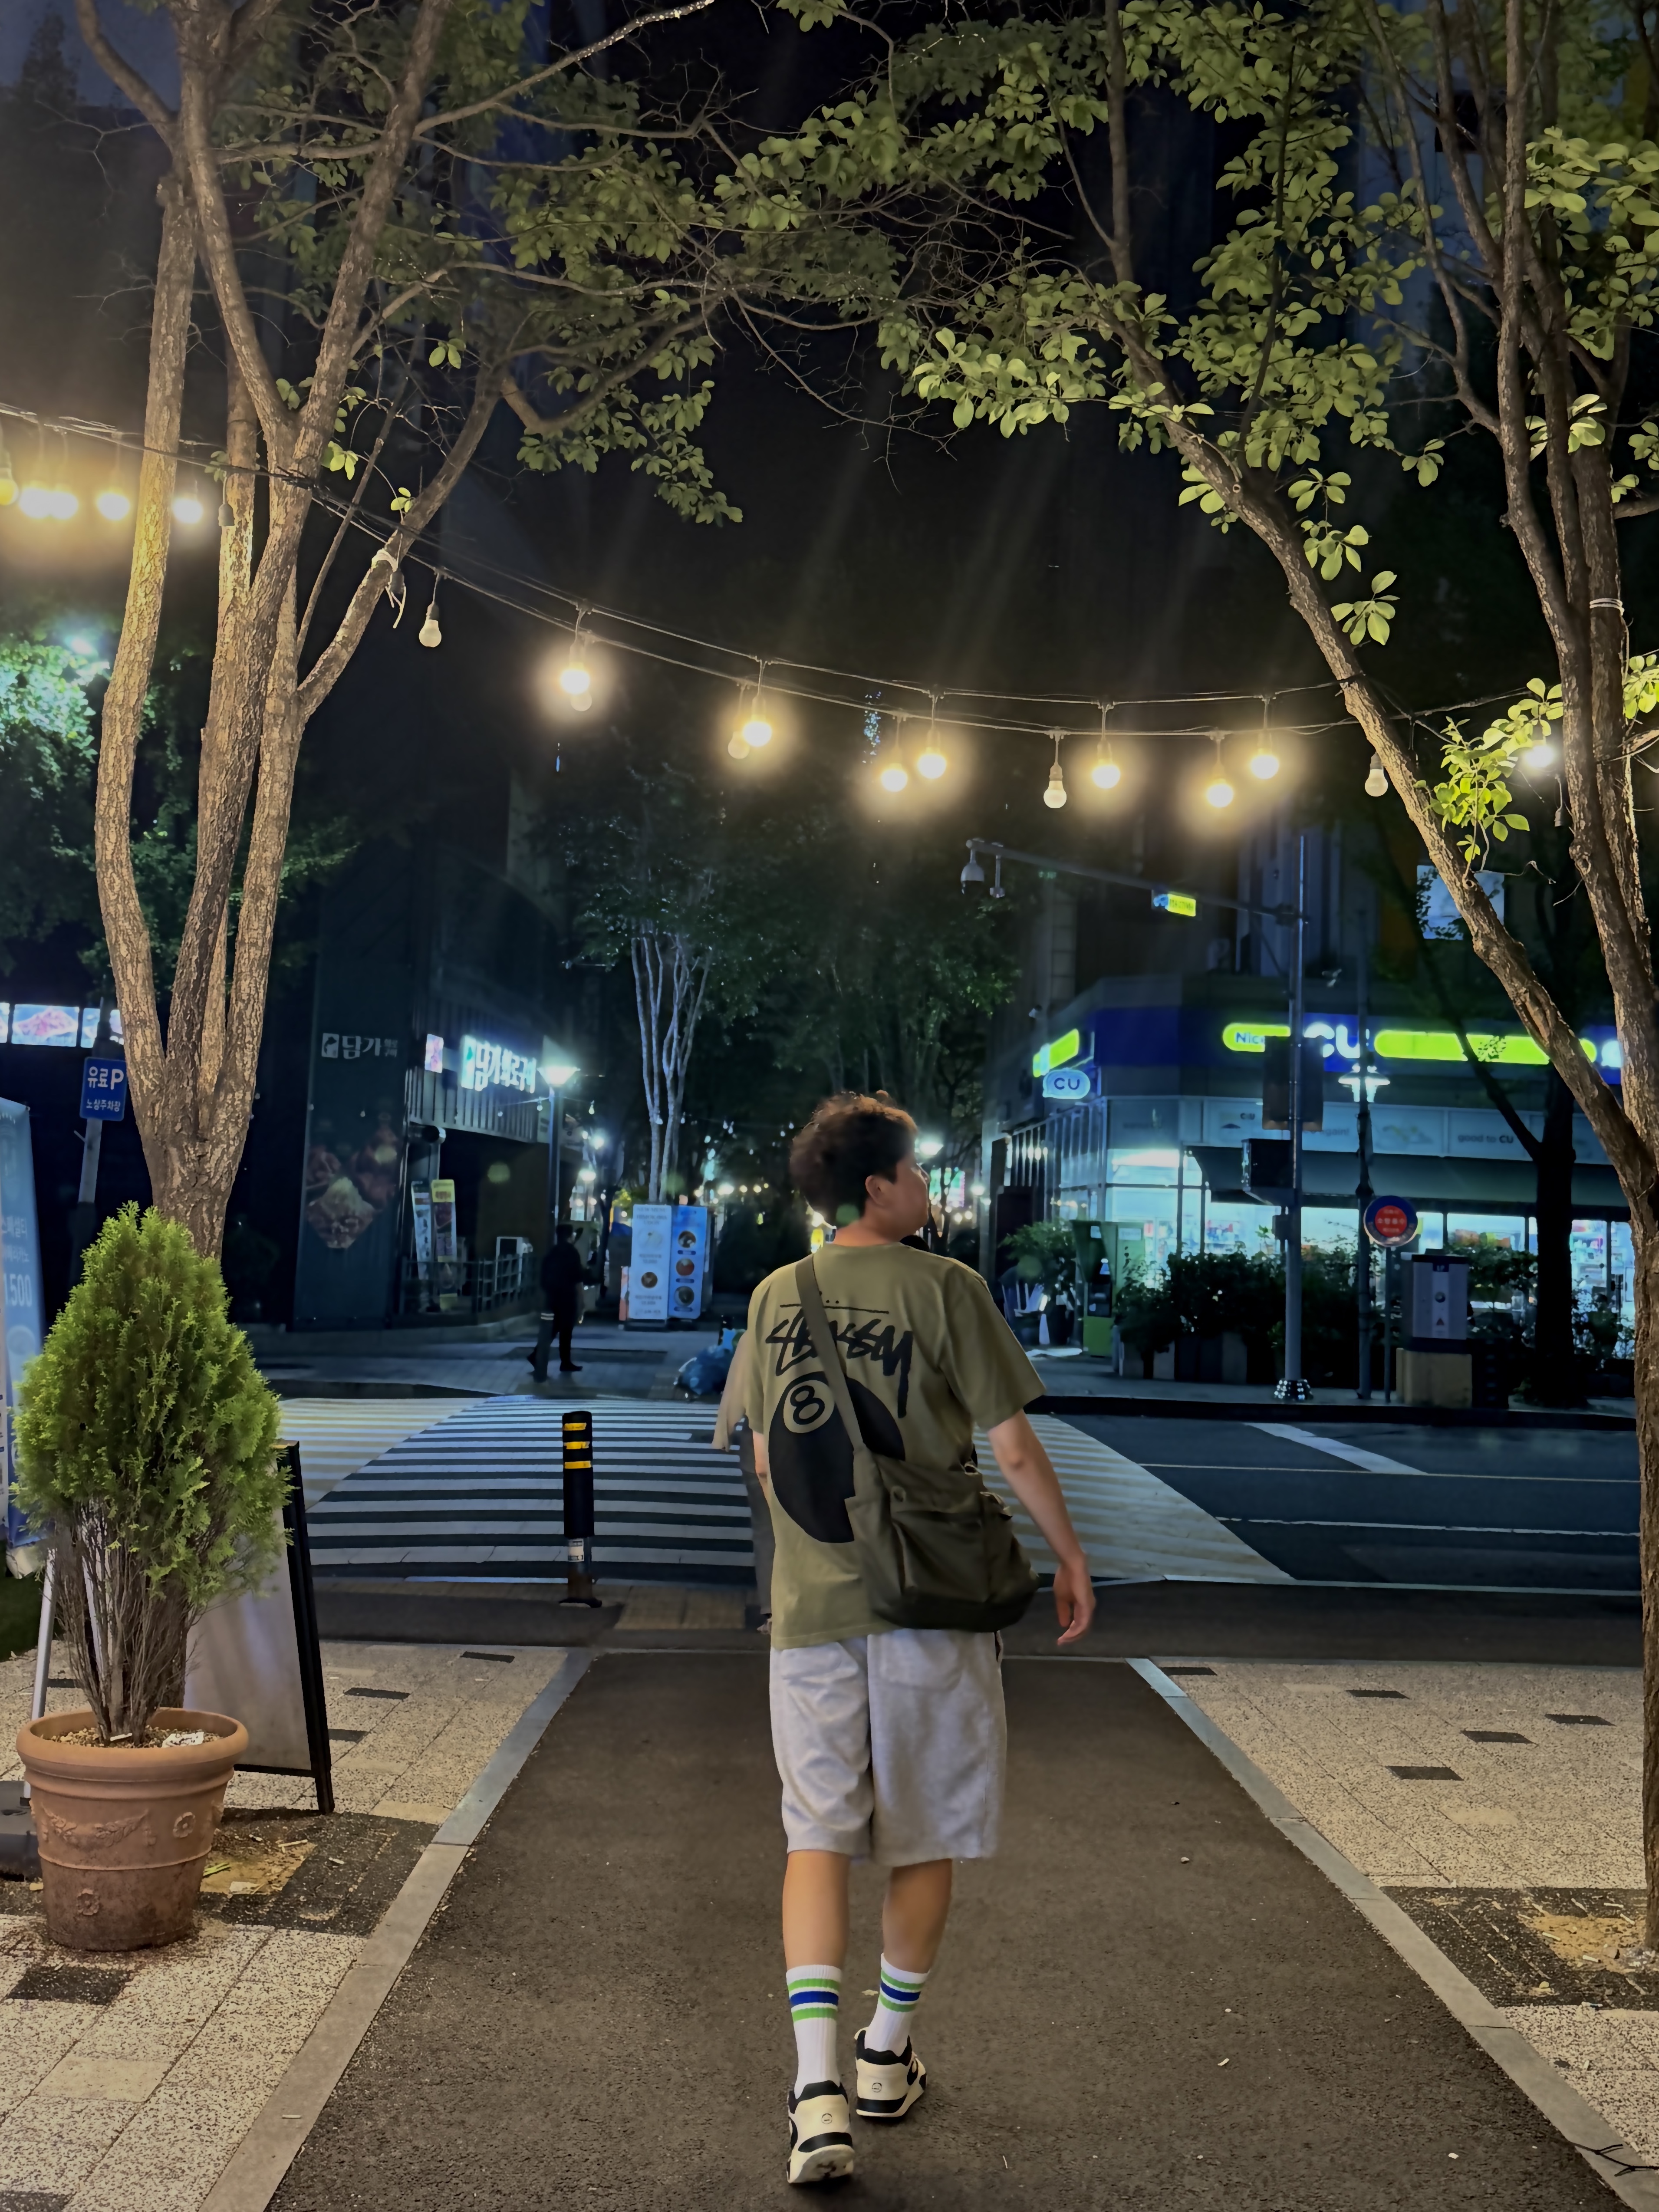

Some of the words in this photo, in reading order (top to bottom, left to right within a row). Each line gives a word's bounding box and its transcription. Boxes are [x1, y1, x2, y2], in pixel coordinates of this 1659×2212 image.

[1054, 1077, 1080, 1090] CU
[86, 1099, 121, 1112] 노상주차장
[1499, 1135, 1514, 1143] CU
[790, 1385, 825, 1425] 8
